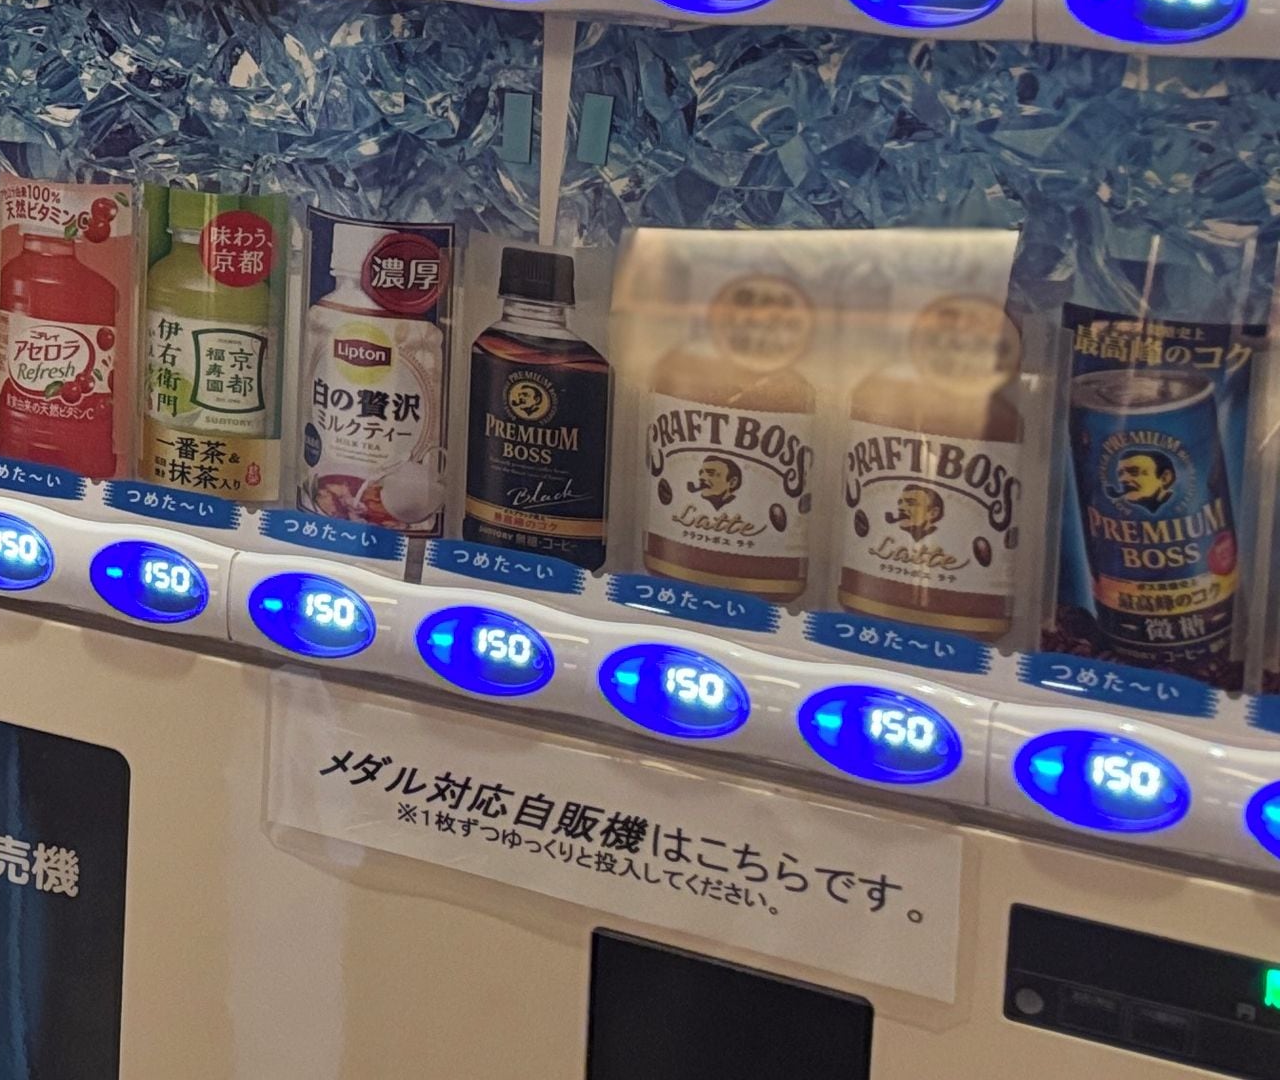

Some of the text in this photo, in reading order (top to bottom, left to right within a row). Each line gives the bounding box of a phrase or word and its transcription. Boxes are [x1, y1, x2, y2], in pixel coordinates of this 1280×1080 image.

[212, 249, 265, 275] 京都
[371, 255, 441, 291] 濃厚
[13, 339, 81, 363] アセロラ
[336, 341, 387, 363] Lipton
[17, 361, 76, 382] Refresh
[311, 378, 420, 425] 白の贅沢
[316, 411, 413, 442] ミルクティー
[484, 418, 580, 453] PREMIUM
[503, 442, 552, 465] BOSS
[646, 411, 813, 504] CRAFT BOSS
[1122, 540, 1202, 569] BOSS
[666, 665, 724, 705] 150
[318, 748, 926, 926] メダル対応自販機はこちらです。
[395, 800, 781, 916] ※1枚ずつゆっくりと投入してください。
